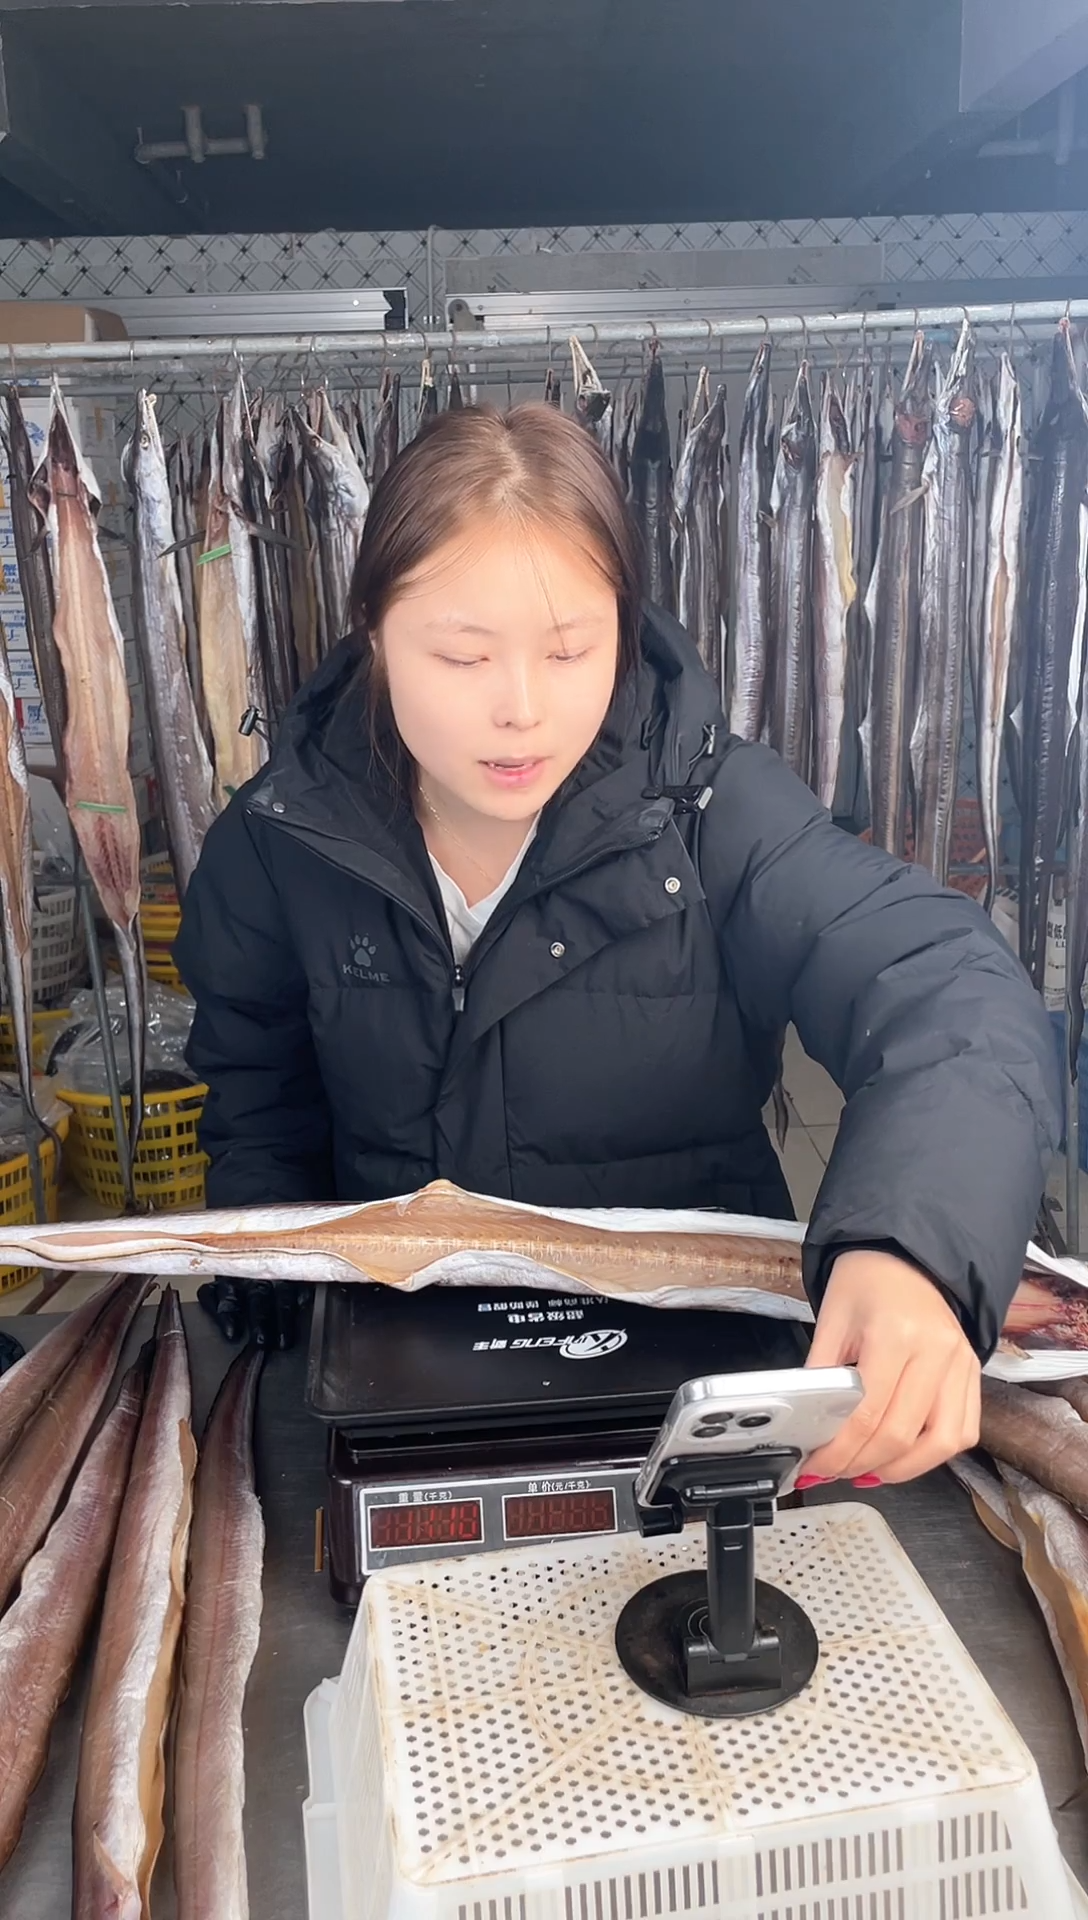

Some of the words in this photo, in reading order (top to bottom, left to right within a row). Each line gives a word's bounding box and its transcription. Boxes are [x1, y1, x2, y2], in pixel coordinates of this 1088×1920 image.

[342, 963, 390, 982] KELME
[507, 1309, 585, 1324] 超级省电
